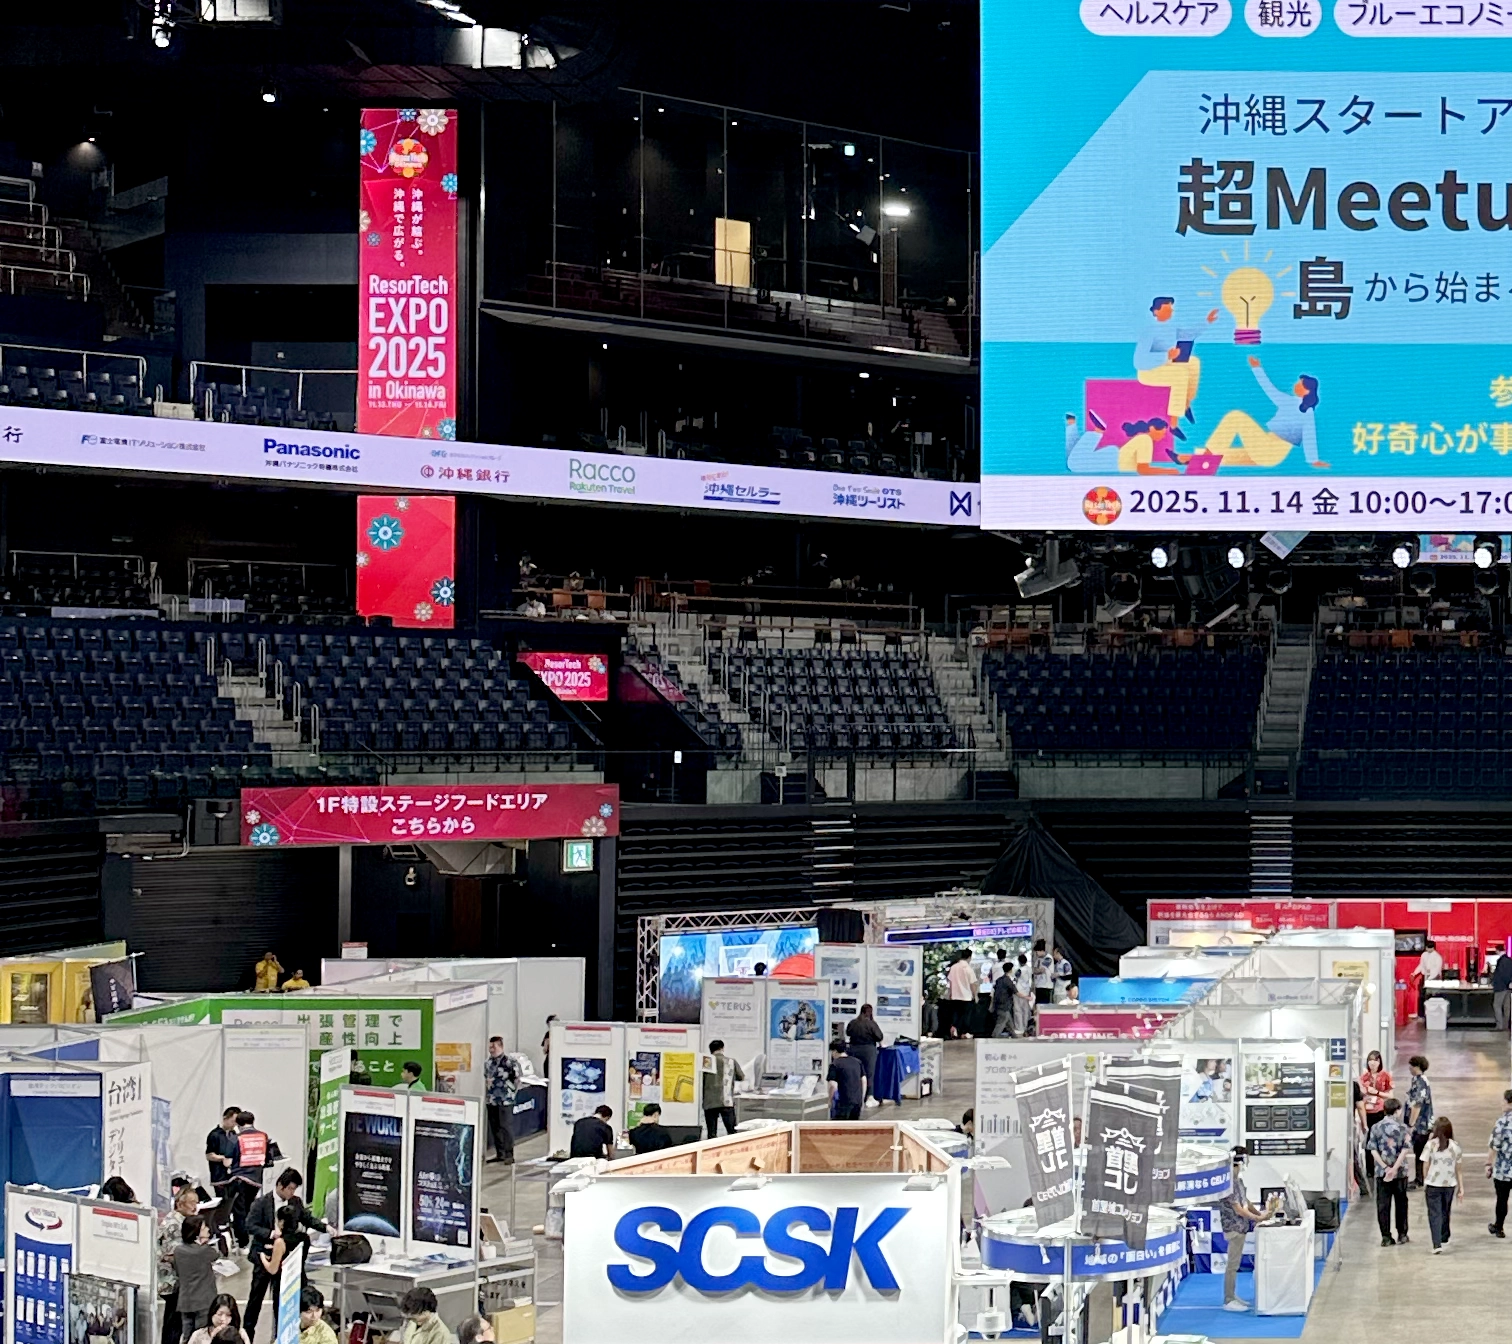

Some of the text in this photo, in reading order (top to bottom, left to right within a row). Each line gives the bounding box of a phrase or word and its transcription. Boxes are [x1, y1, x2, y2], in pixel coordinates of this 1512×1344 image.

[1100, 0, 1220, 27] ヘルスケア
[1258, 0, 1312, 28] 観光
[368, 274, 449, 296] ResorTech
[368, 297, 449, 334] EXPO
[367, 336, 447, 378] 2025
[368, 379, 447, 400] in Okinawa
[3, 425, 24, 444] 行
[263, 438, 361, 460] Panasonic
[438, 466, 511, 484] 沖縄銀行
[569, 457, 637, 484] Racco
[608, 483, 637, 496] Travel
[704, 482, 782, 500] 沖縄セルラー
[832, 492, 905, 510] 沖縄ツーリスト
[1270, 490, 1303, 514] 14
[1311, 487, 1340, 516] 金
[564, 671, 592, 688] 2025
[316, 792, 549, 815] 1F特設ステージフードエリア
[390, 817, 476, 835] こちらから
[318, 1031, 403, 1047] 産性向上
[1104, 1145, 1140, 1176] 首里
[606, 1206, 912, 1293] SCSK
